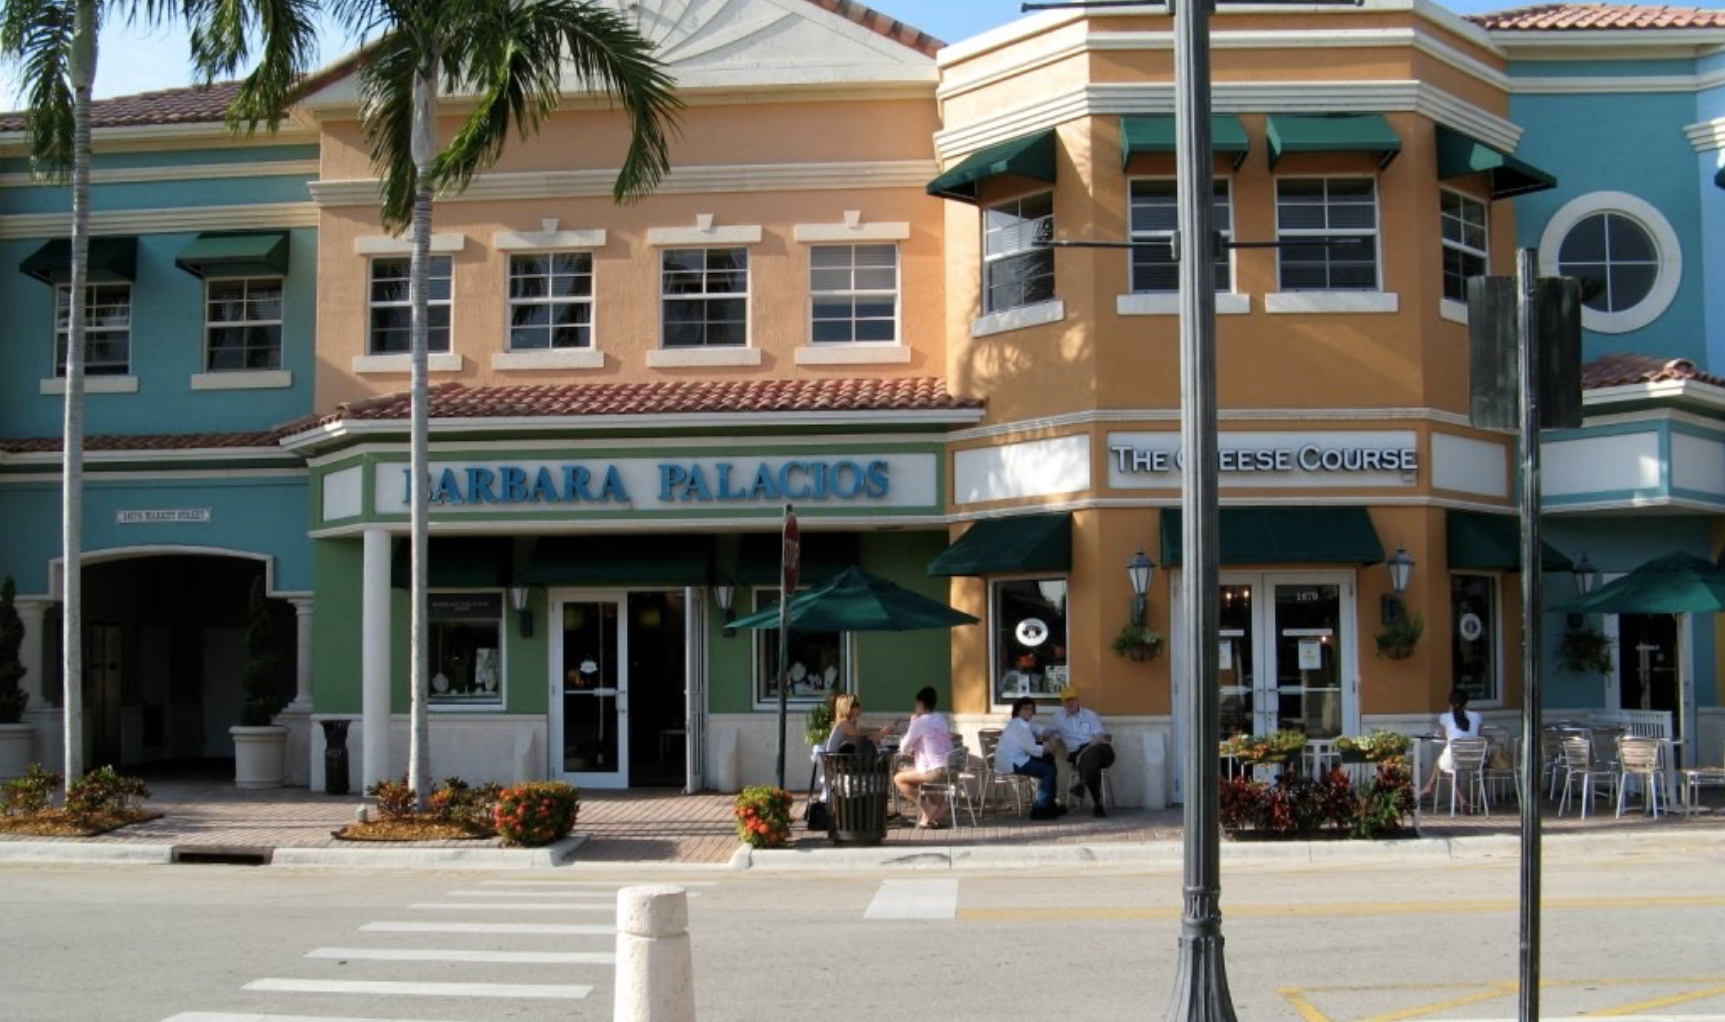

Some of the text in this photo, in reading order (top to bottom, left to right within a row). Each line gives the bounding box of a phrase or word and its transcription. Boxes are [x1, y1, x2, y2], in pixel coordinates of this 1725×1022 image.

[1109, 444, 1418, 473] THE EESE COURSE
[657, 460, 890, 502] PALACIOS
